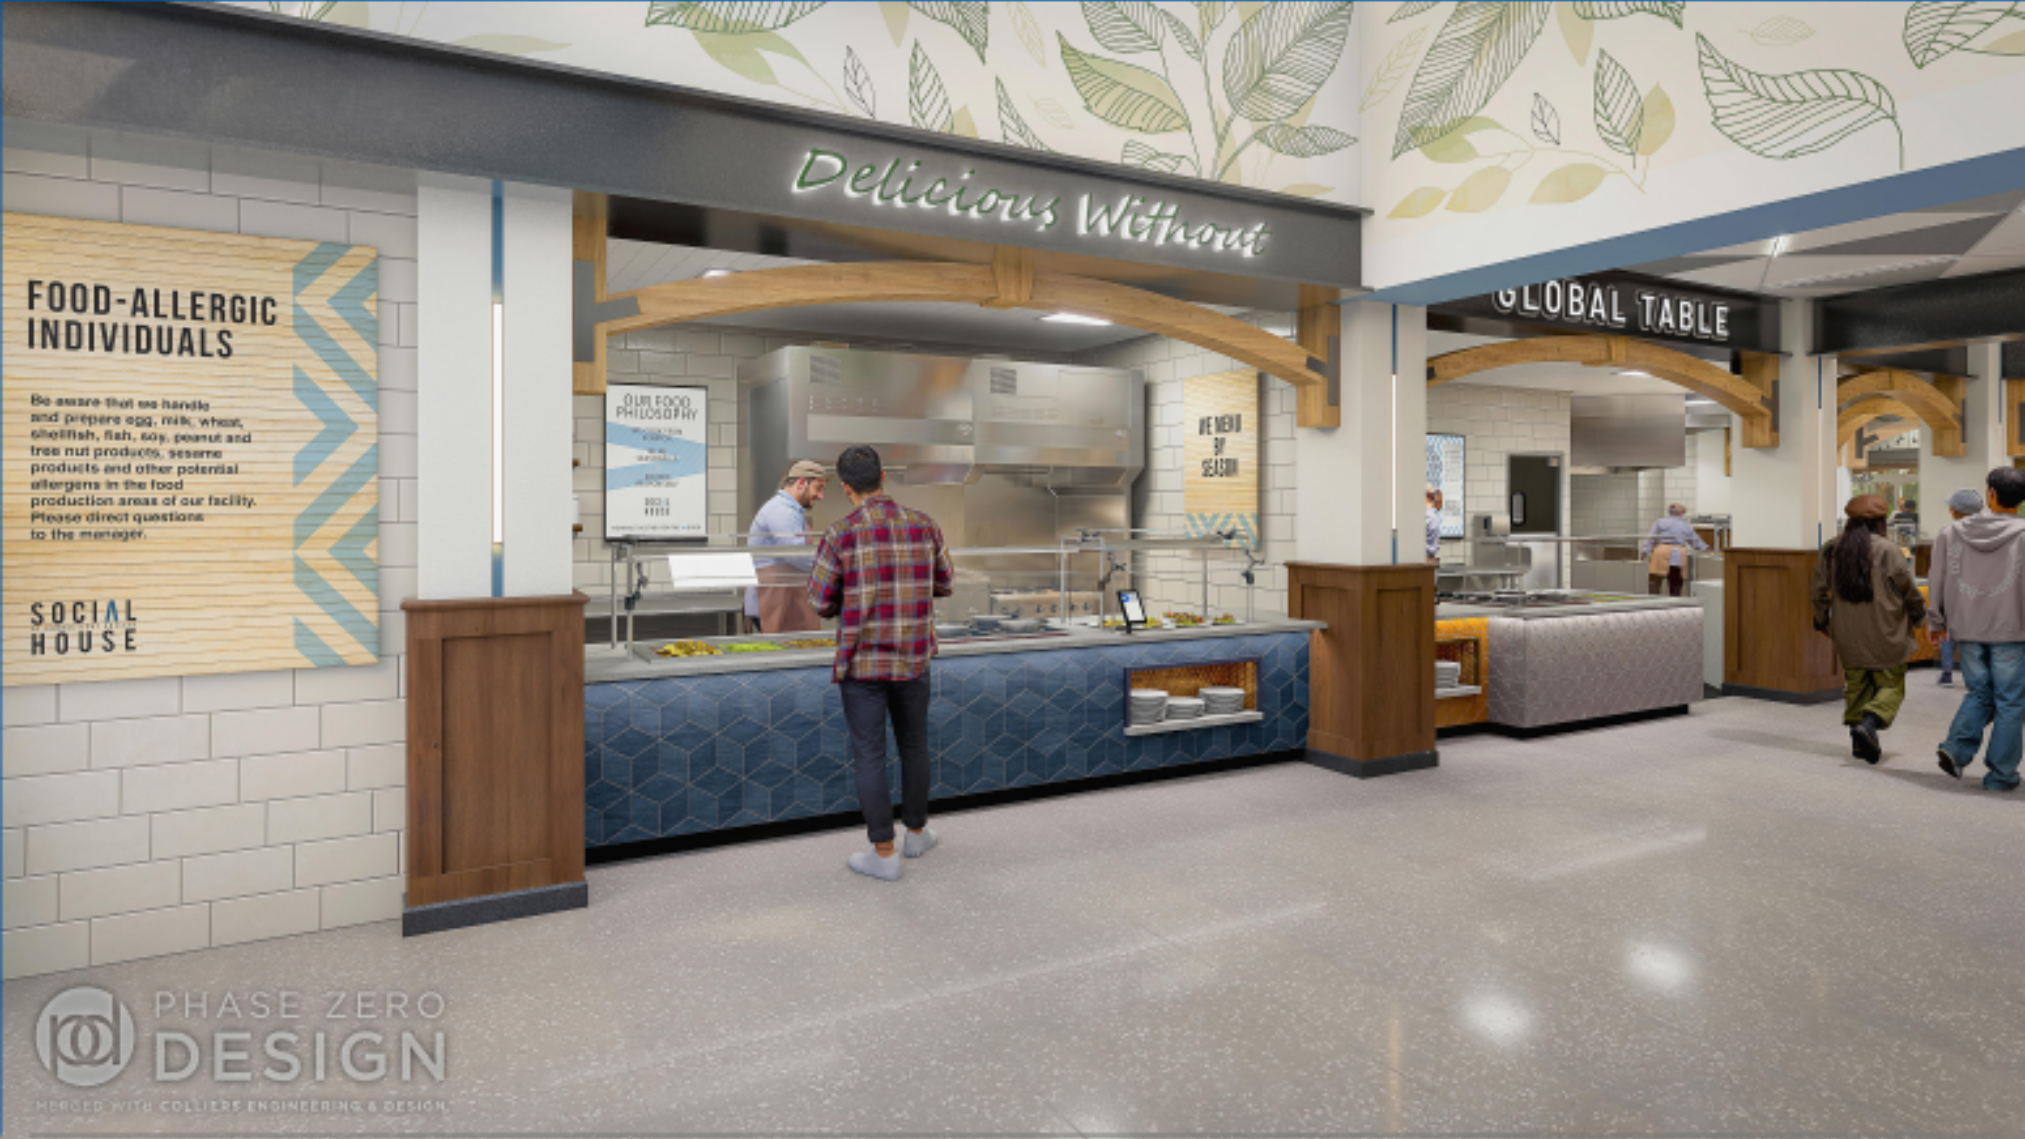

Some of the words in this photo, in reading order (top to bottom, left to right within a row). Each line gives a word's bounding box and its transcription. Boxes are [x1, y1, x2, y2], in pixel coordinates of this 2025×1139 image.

[791, 146, 1060, 233] Delicious
[1074, 191, 1274, 259] Without
[28, 279, 277, 326] FOOD-ALLERGIC
[1498, 280, 1627, 324] GLOBAL
[1640, 293, 1730, 337] TABLE
[28, 317, 233, 358] INDIVIDUALS
[31, 393, 51, 407] Be
[56, 397, 100, 408] aware
[105, 397, 134, 409] that
[138, 400, 158, 409] we
[162, 399, 210, 412] handle
[31, 412, 58, 423] and
[65, 414, 121, 426] prepare
[125, 415, 157, 428] egg,
[162, 415, 195, 427] milk,
[199, 416, 244, 429] wheat,
[31, 429, 100, 442] shellfish,
[104, 430, 137, 442] fish,
[141, 433, 170, 445] soy,
[174, 432, 222, 444] peanut
[226, 433, 251, 443] and
[31, 446, 60, 456] tree
[65, 446, 90, 456] nut
[94, 446, 164, 459] products,
[169, 448, 222, 459] sesame
[31, 462, 99, 475] products
[104, 463, 131, 474] and
[135, 463, 173, 474] other
[177, 464, 239, 476] potential
[31, 479, 100, 492] allergens
[105, 480, 118, 490] in
[123, 479, 147, 490] the
[151, 479, 183, 490] food
[31, 495, 113, 508] production
[117, 497, 158, 506] areas
[162, 495, 177, 506] of
[180, 497, 204, 506] our
[208, 495, 257, 508] facility.
[31, 511, 82, 523] Please
[86, 511, 129, 522] direct
[133, 511, 204, 524] questions
[31, 529, 46, 540] to
[52, 529, 74, 540] the
[79, 530, 147, 541] manager.
[31, 599, 137, 626] SOCIAL
[31, 628, 137, 656] HOUSE
